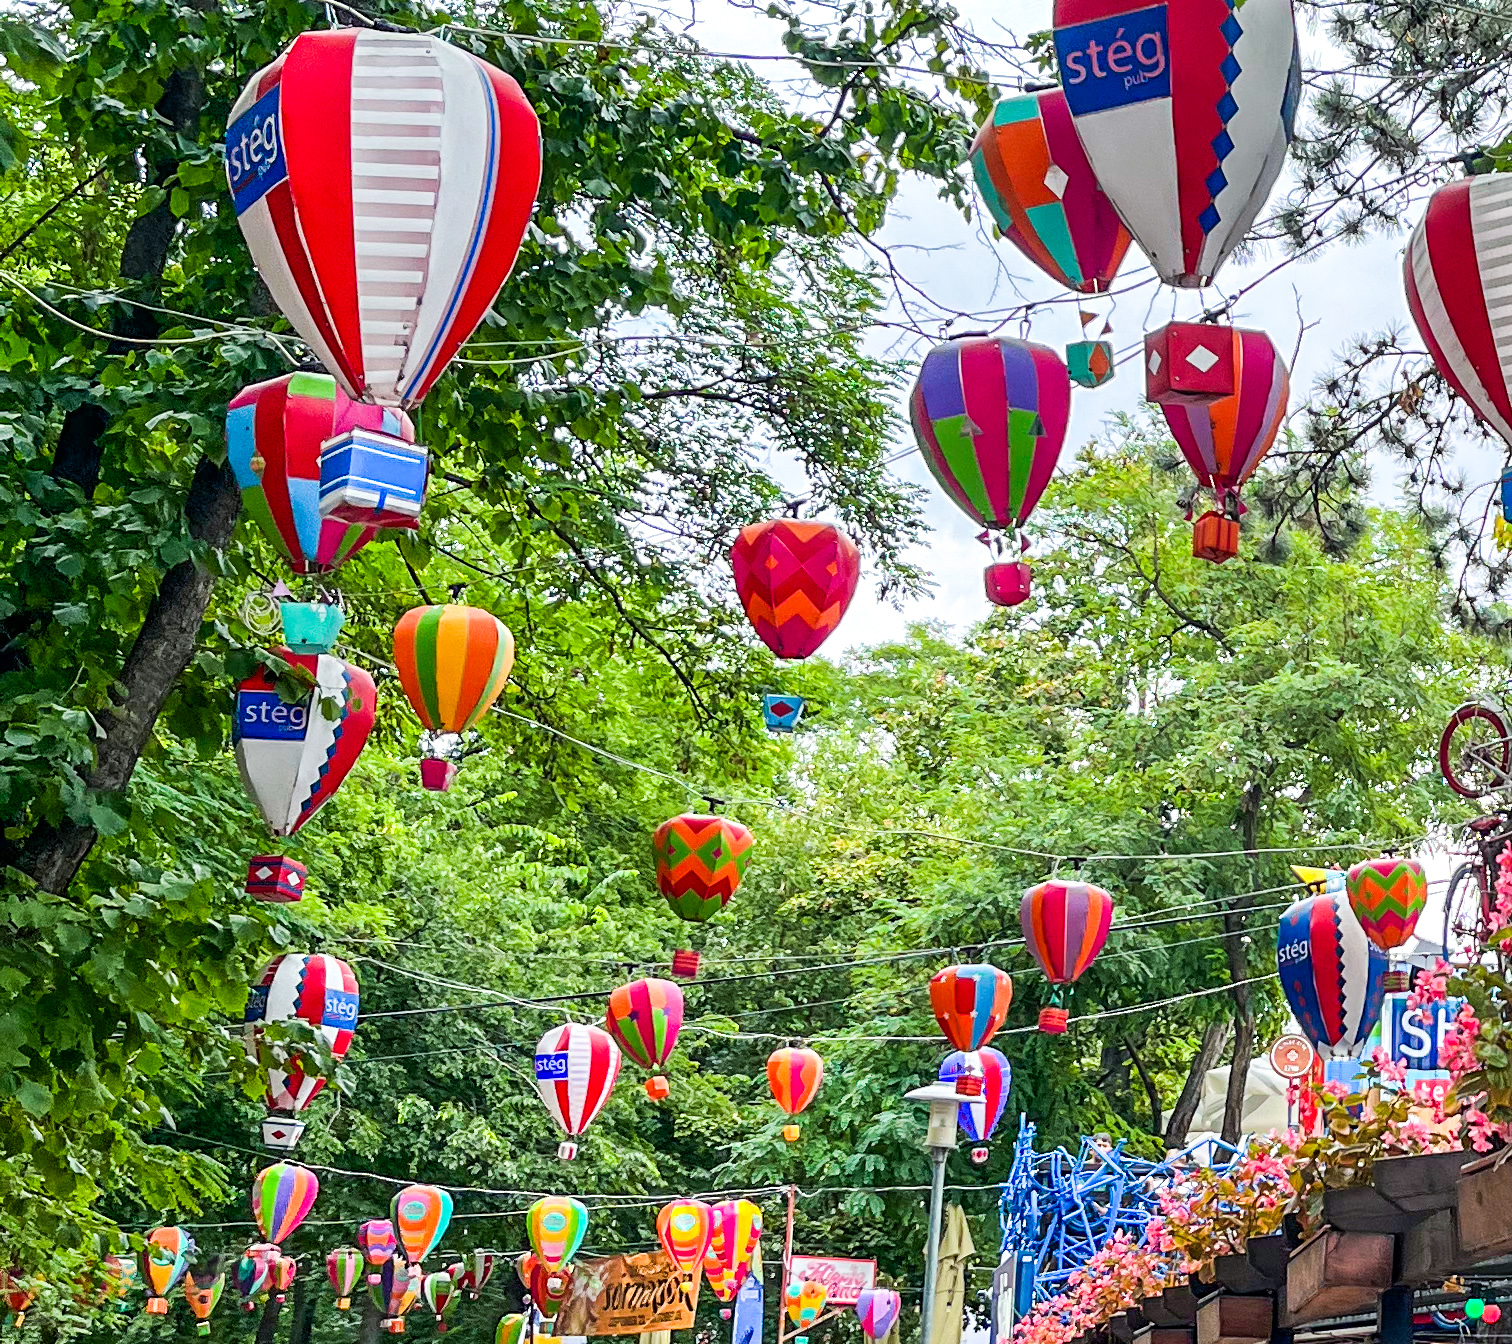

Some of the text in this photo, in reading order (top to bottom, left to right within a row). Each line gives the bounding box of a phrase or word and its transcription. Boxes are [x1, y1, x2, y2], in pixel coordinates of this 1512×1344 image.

[1066, 27, 1166, 85] stég
[1123, 70, 1149, 91] pub
[231, 113, 278, 181] stég
[1279, 938, 1309, 964] stég
[325, 994, 357, 1021] stég
[535, 1055, 566, 1075] stég
